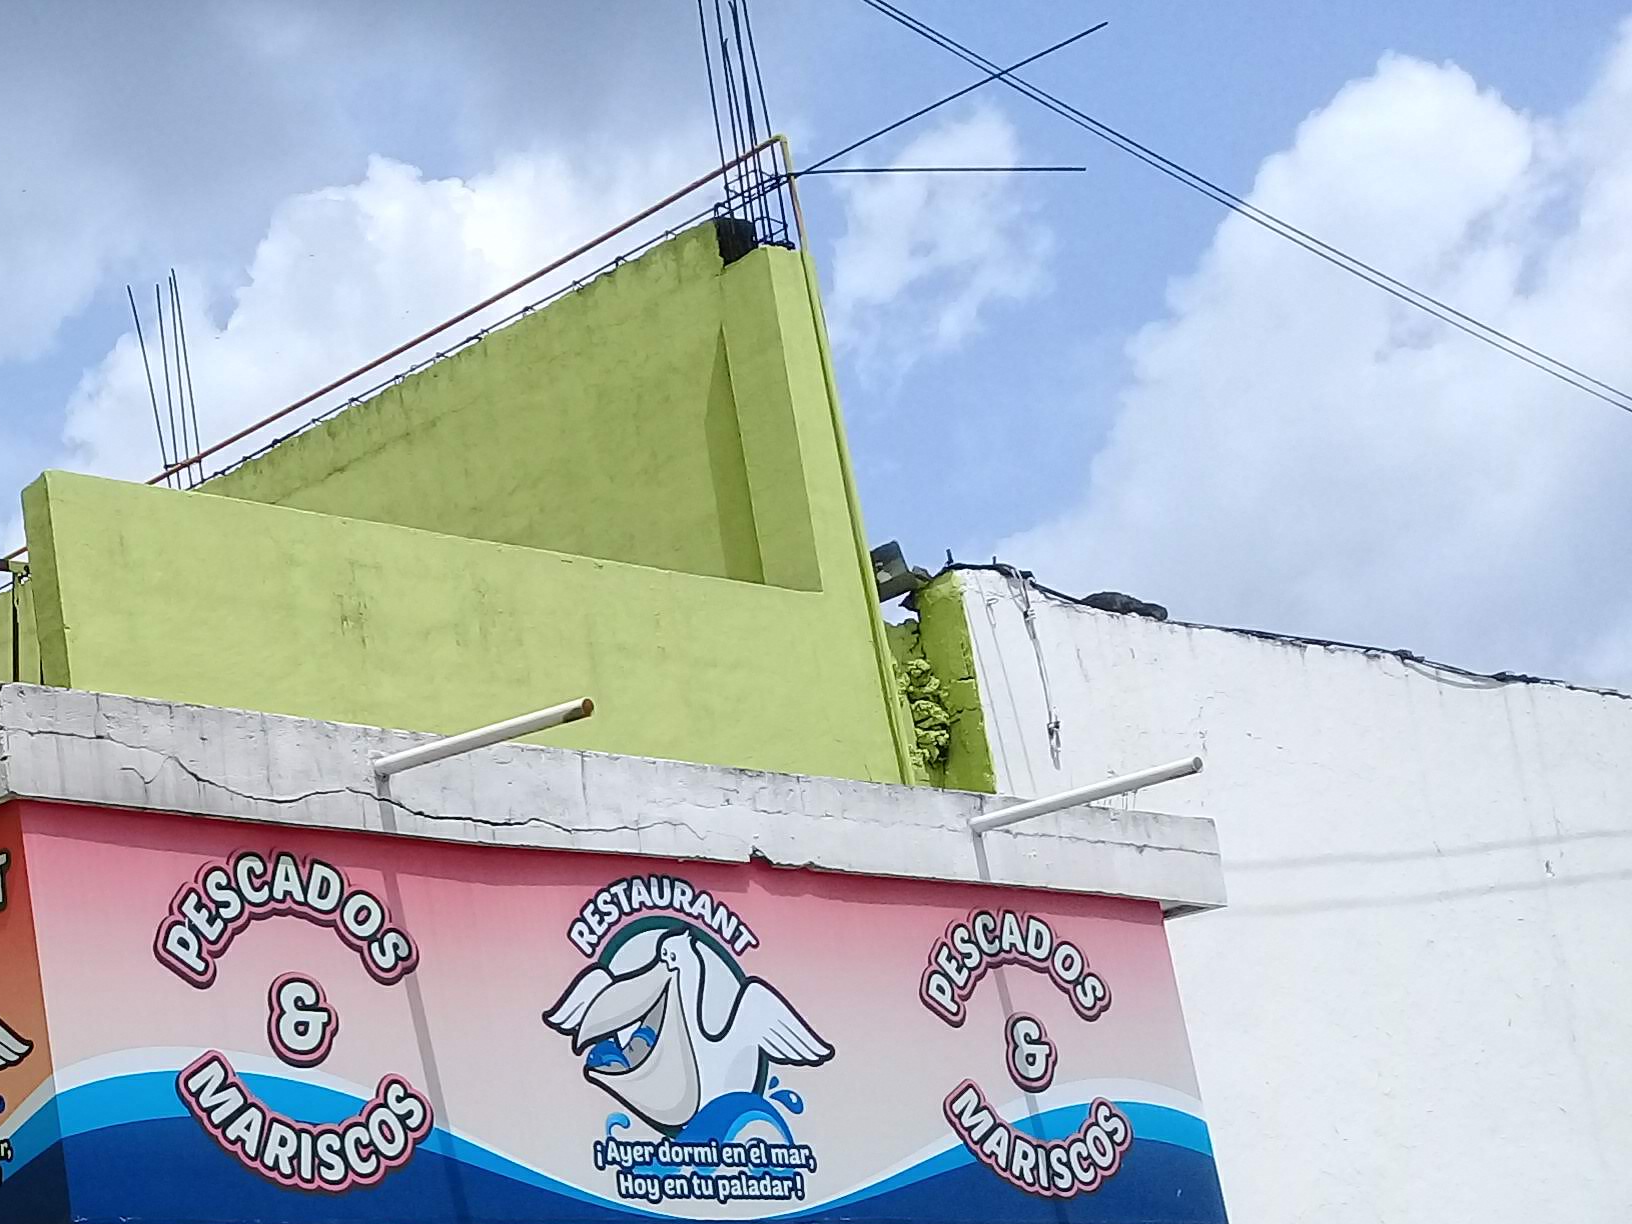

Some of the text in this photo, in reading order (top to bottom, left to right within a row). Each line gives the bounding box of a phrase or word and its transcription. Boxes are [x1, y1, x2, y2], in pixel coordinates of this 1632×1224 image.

[164, 852, 413, 974] PESCADOS
[569, 875, 759, 956] RESTAURANT
[925, 908, 1107, 1016] PESCADOS
[273, 976, 331, 1056] &
[1009, 1015, 1053, 1083] &
[183, 1057, 429, 1185] MARISCOS
[658, 1140, 718, 1164] dormi
[722, 1146, 747, 1164] en
[771, 1146, 815, 1169] mar,
[949, 1085, 1128, 1193] MARISCOS
[619, 1174, 660, 1199] Hoy
[666, 1178, 689, 1196] en
[691, 1176, 714, 1196] tu
